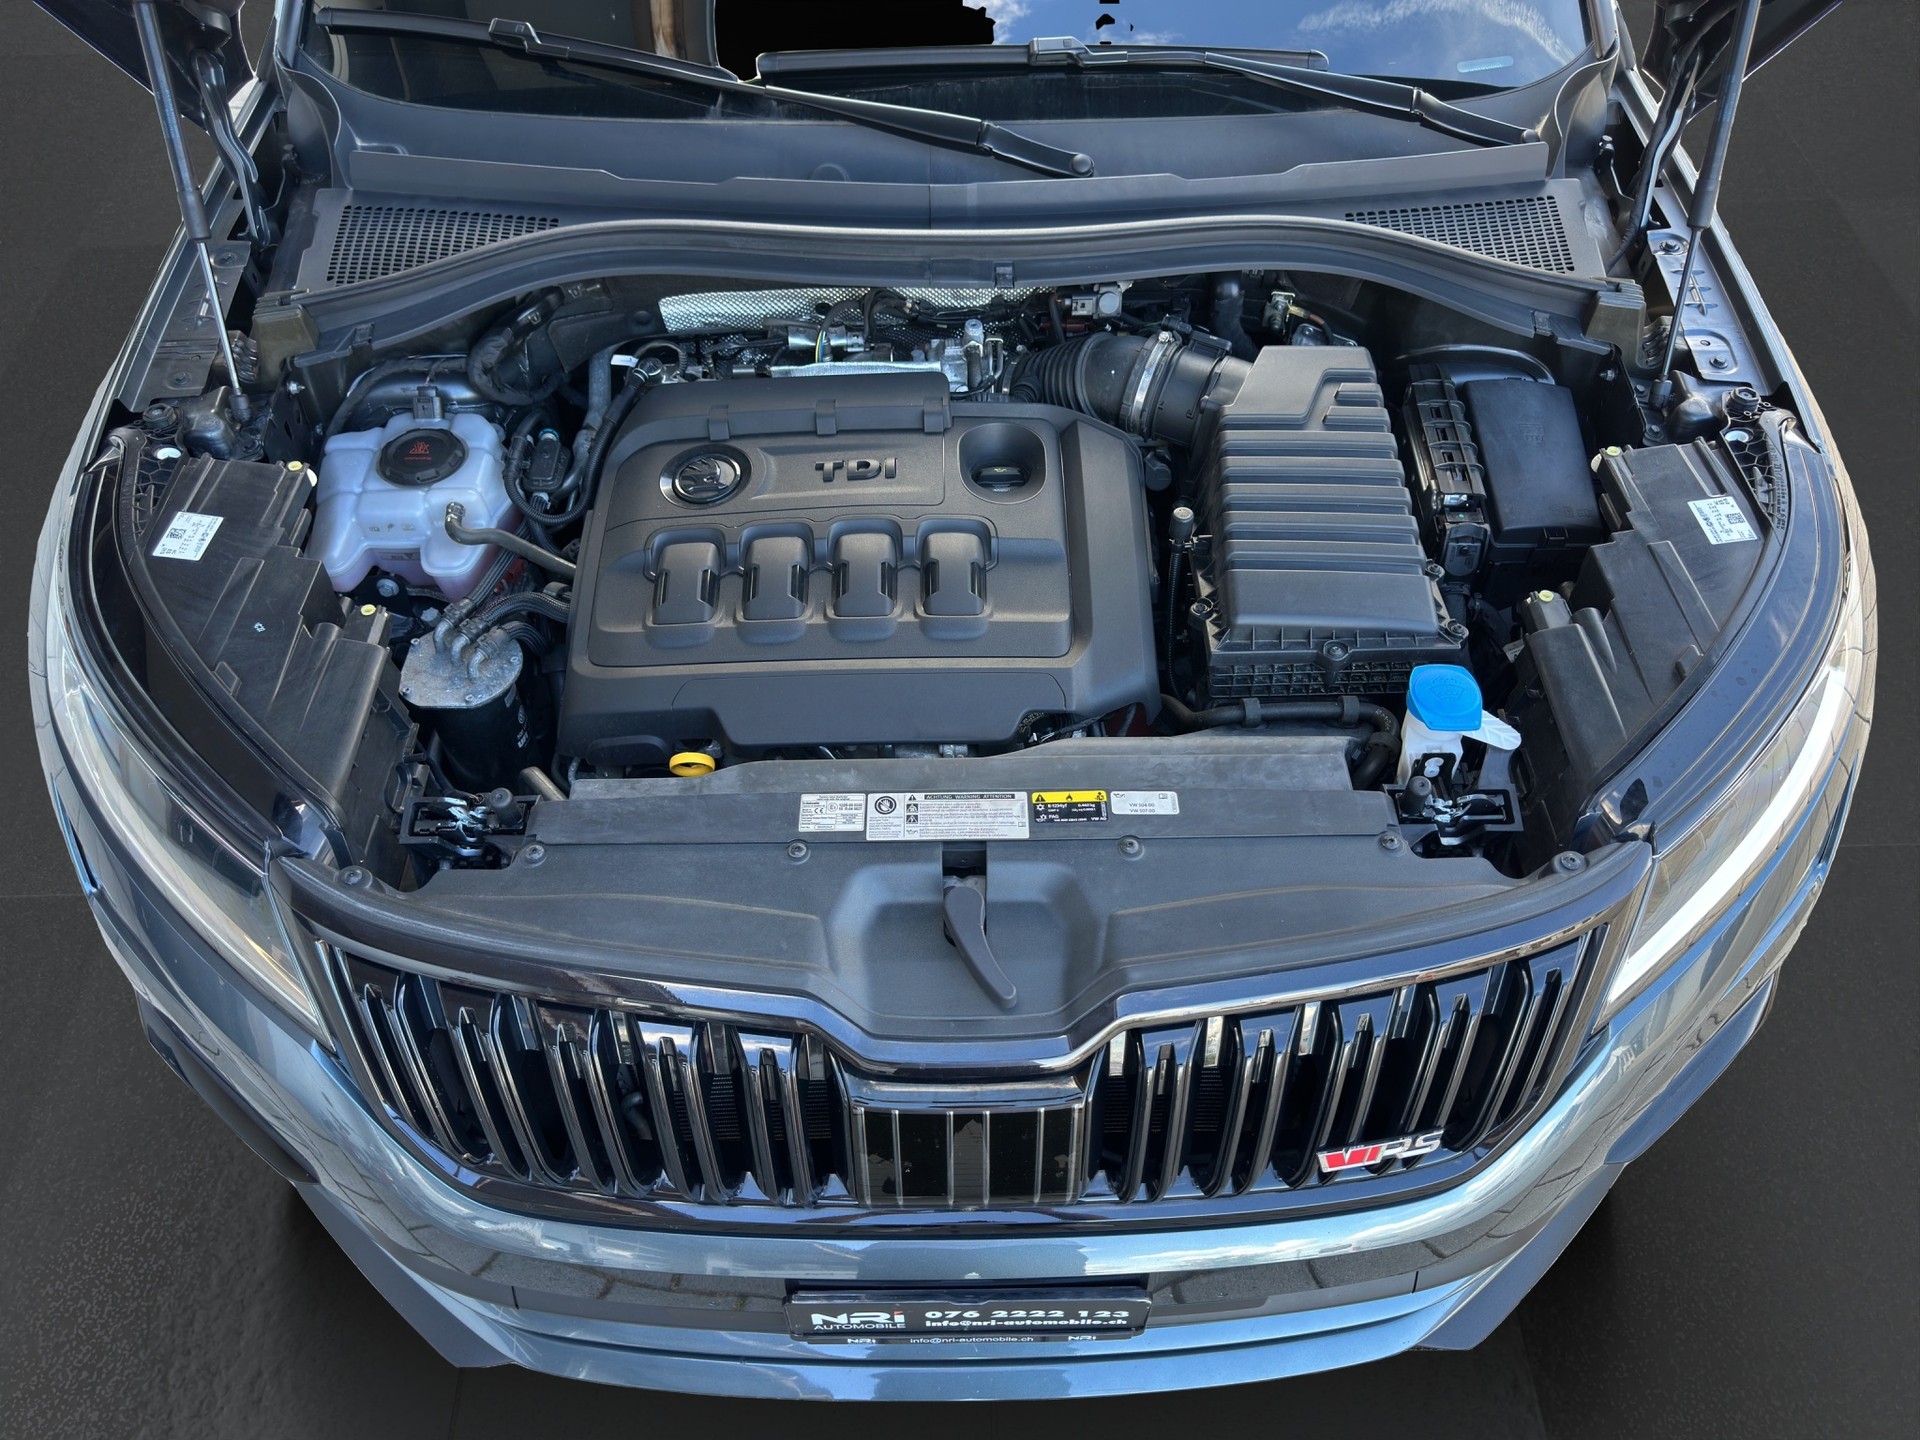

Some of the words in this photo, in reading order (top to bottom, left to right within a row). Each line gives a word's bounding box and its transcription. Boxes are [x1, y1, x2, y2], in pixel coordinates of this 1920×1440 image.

[815, 457, 898, 482] TDI
[925, 1310, 980, 1319] 076
[990, 1310, 1065, 1319] 2222
[1078, 1310, 1130, 1318] 123
[813, 1323, 906, 1331] AUTOMOBILE
[925, 1319, 1128, 1327] info@nri-automobile.ch
[910, 1336, 1034, 1344] info@nri-automobile.ch
